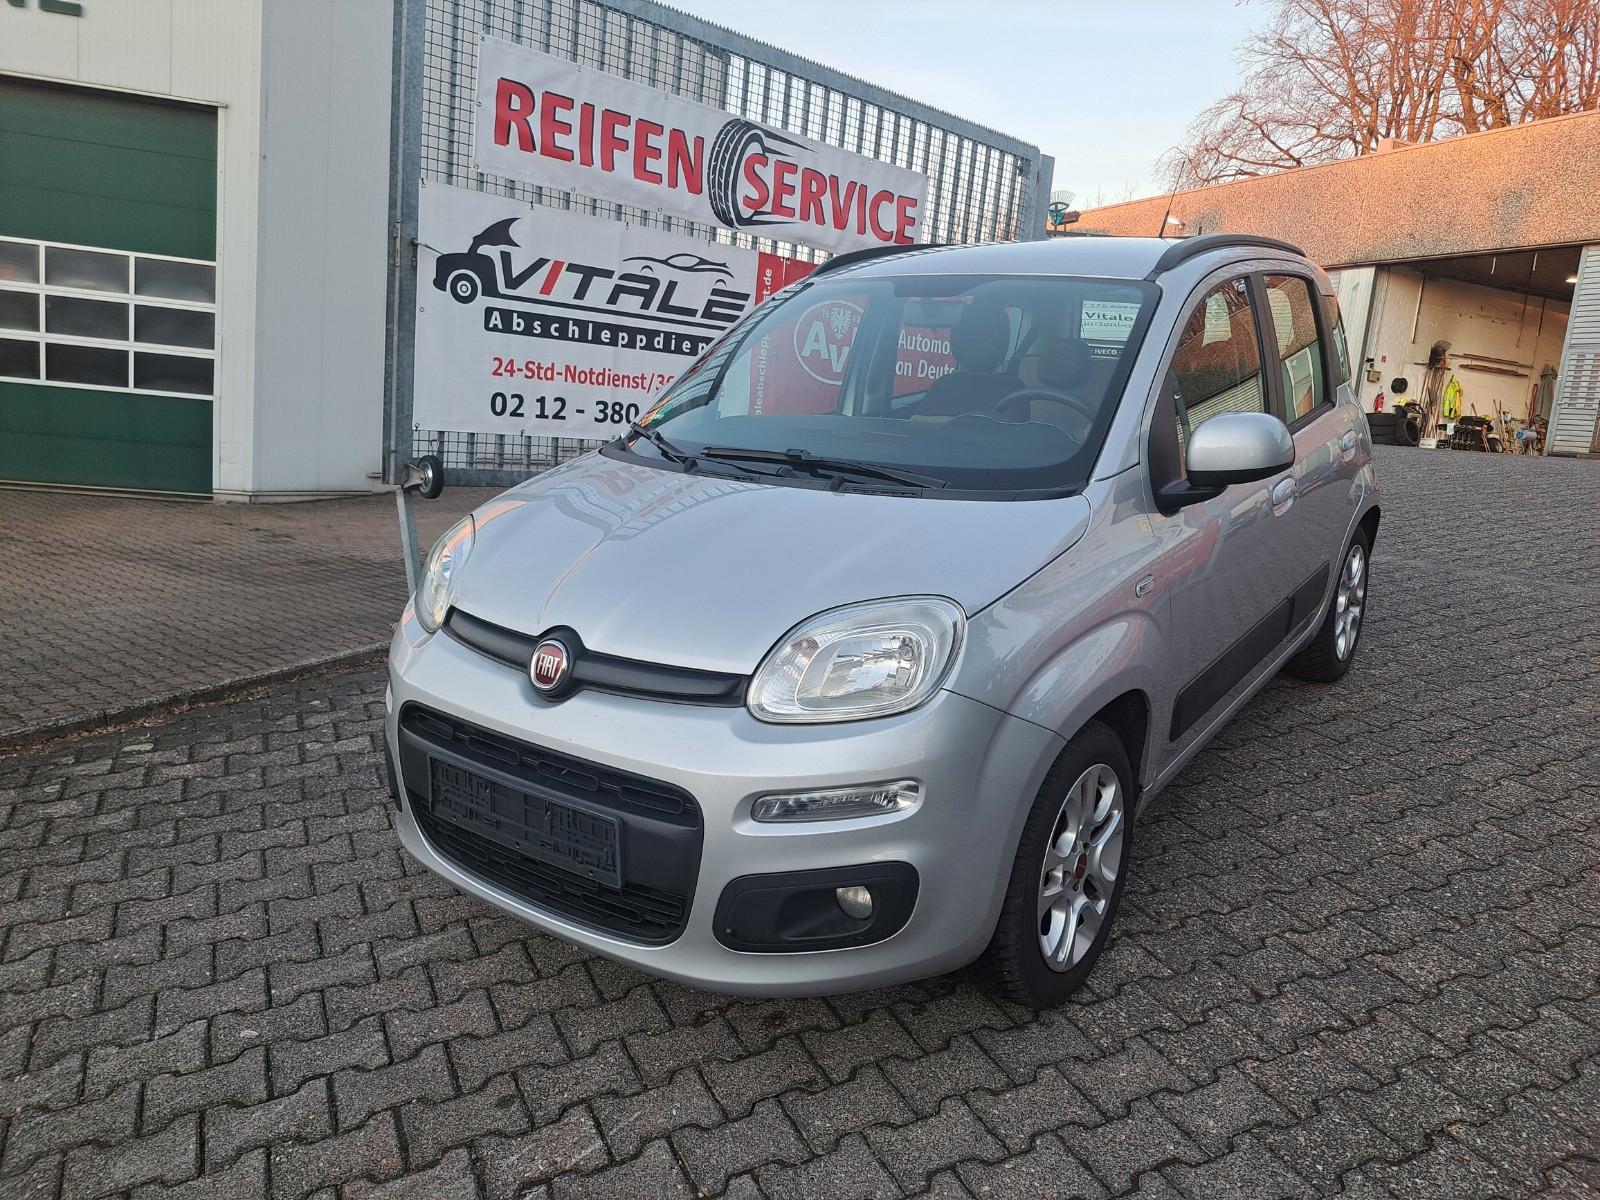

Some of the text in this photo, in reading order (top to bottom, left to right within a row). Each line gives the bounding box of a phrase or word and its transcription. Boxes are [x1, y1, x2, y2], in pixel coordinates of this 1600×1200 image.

[494, 77, 917, 245] REIFEN SERVICE
[500, 251, 750, 323] VITALE
[898, 329, 953, 355] Automo
[490, 391, 524, 418] 02
[535, 395, 567, 421] 12
[594, 400, 640, 425] 380
[537, 653, 560, 679] FIAT
